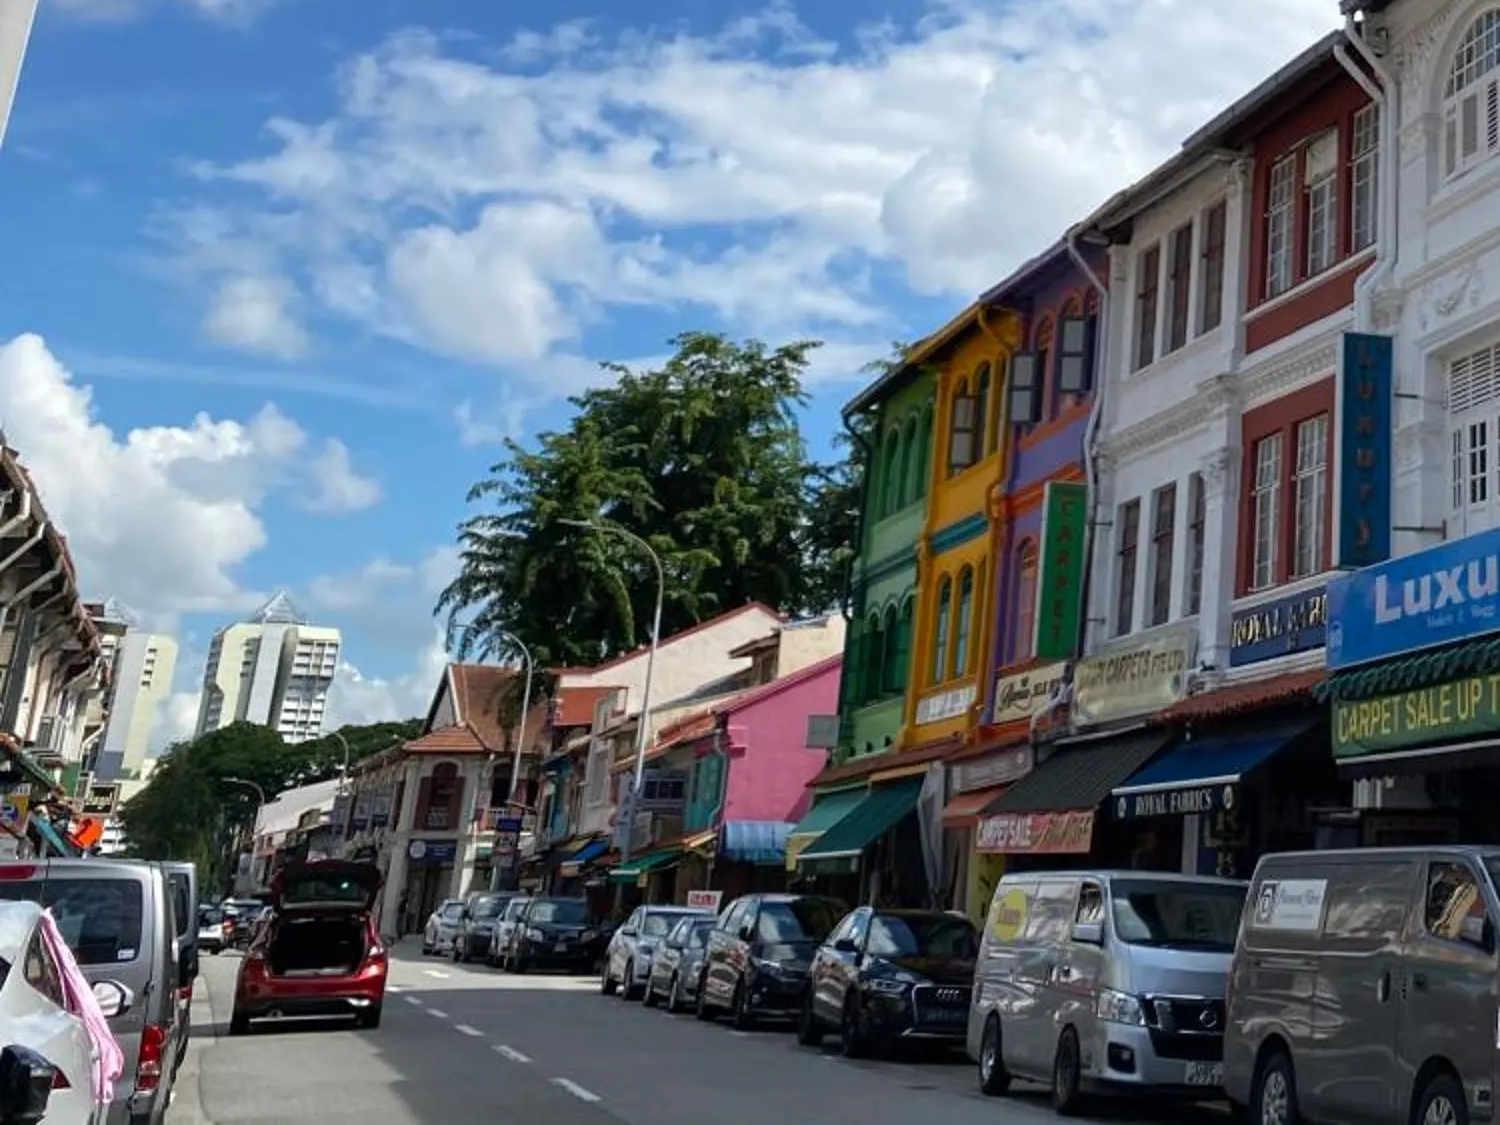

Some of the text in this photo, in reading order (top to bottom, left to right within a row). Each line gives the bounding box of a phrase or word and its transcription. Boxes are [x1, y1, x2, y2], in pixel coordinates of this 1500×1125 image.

[1231, 606, 1284, 648] ROYAL
[1338, 694, 1400, 744] CARPET
[1406, 685, 1453, 731] SALE
[1457, 678, 1482, 719] UP
[1134, 787, 1213, 817] ROYAL FABRICS
